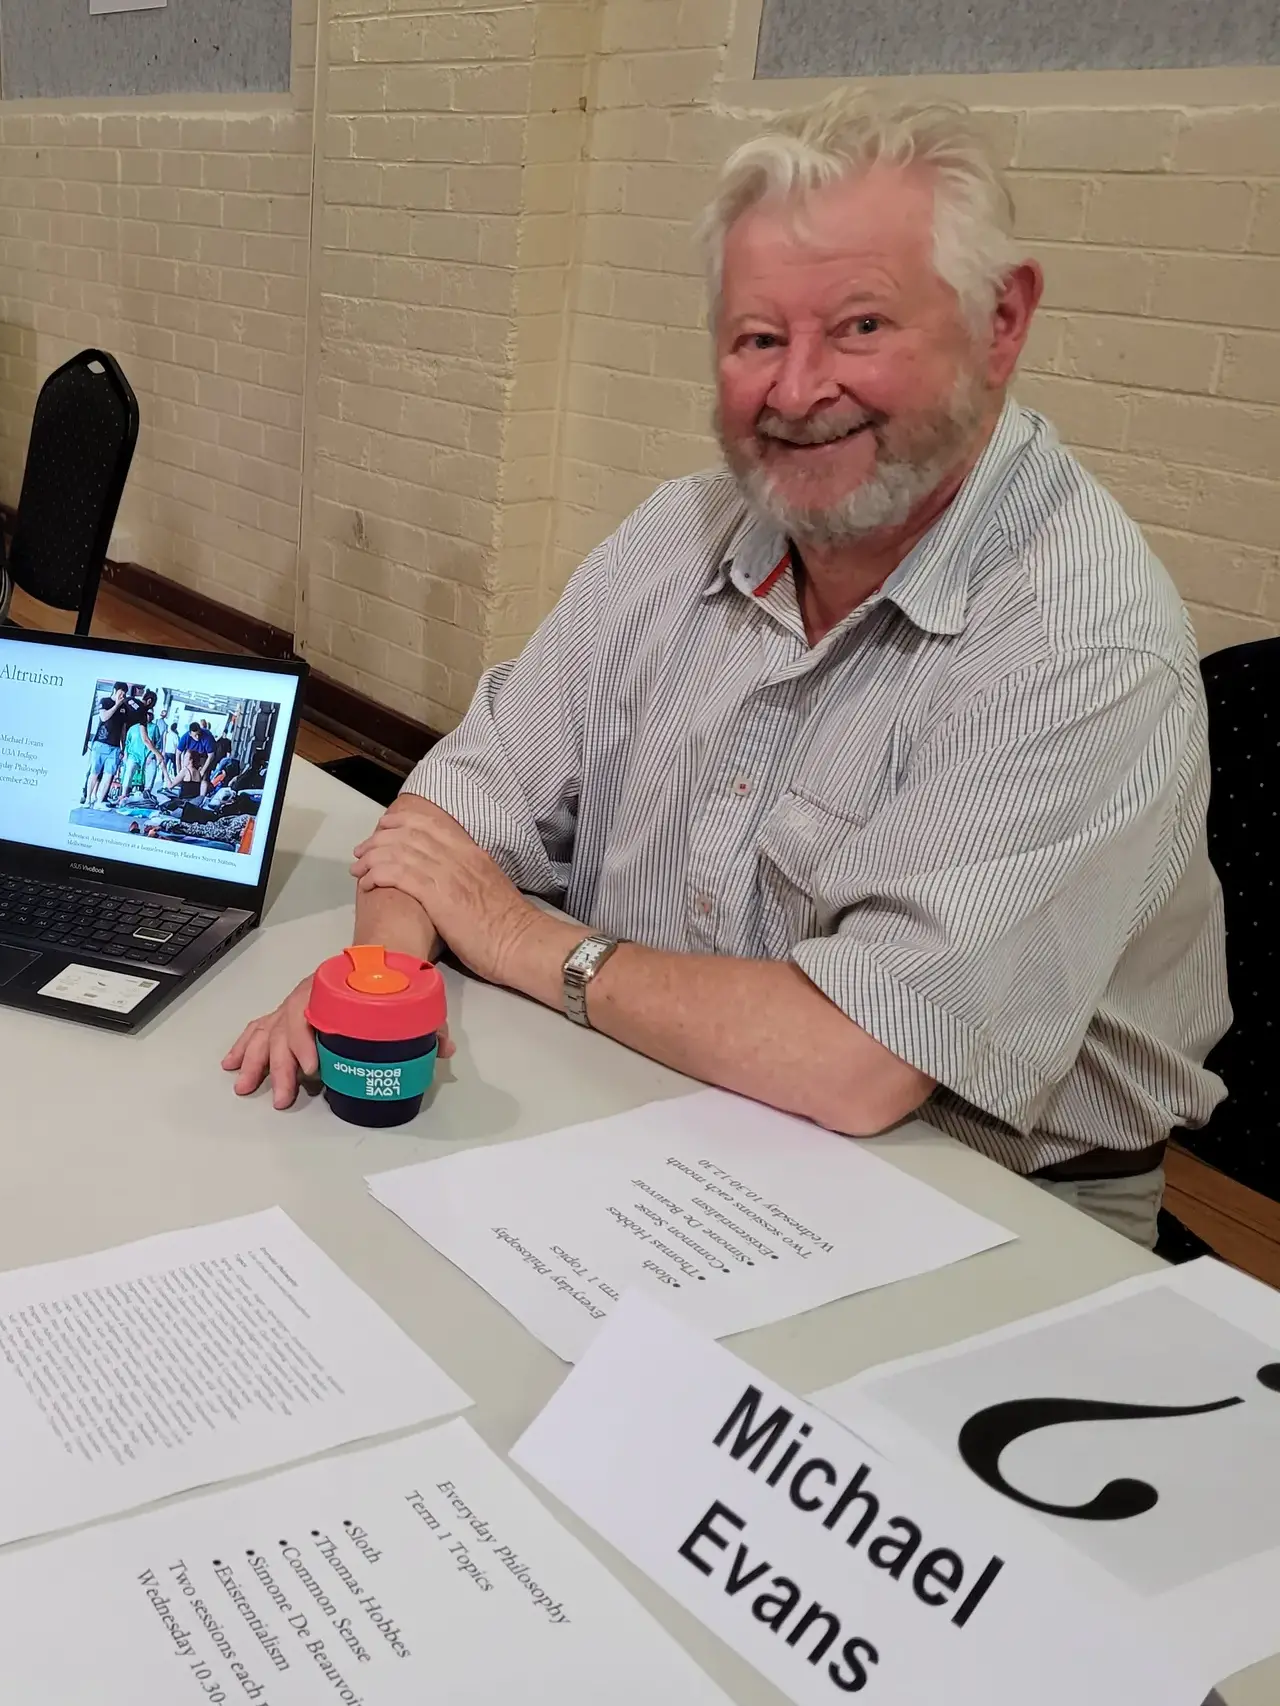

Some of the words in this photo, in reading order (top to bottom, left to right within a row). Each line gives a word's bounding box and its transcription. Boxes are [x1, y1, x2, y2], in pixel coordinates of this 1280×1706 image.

[0, 733, 24, 745] Michael
[14, 762, 48, 777] Philosophy
[333, 1062, 402, 1078] BOOKSHOP
[366, 1077, 401, 1087] YOUR
[666, 1156, 707, 1184] month
[631, 1178, 685, 1215] Beauvoir
[705, 1182, 735, 1202] each
[606, 1206, 653, 1241] Hobbes
[634, 1203, 669, 1227] Sense
[683, 1214, 704, 1229] De
[691, 1196, 774, 1257] Existentialism
[732, 1201, 784, 1237] sessions
[762, 1202, 835, 1253] Wednesday
[490, 1226, 553, 1276] Philosophy
[549, 1244, 589, 1278] Topics
[650, 1239, 700, 1278] Thomas
[667, 1225, 725, 1270] Common
[702, 1227, 751, 1263] Simone
[782, 1236, 813, 1260] Two
[641, 1259, 678, 1284] Sloth
[550, 1275, 607, 1320] Everyday
[711, 1383, 1006, 1629] Michael
[344, 1525, 383, 1564] Sloth
[404, 1489, 441, 1531] Term
[437, 1531, 453, 1541] 1
[448, 1540, 494, 1592] Topics
[436, 1480, 497, 1544] Everyday
[492, 1545, 572, 1625] Philosophy
[137, 1568, 196, 1657] Wednesday
[282, 1546, 337, 1617] Common
[332, 1617, 372, 1663] Sense
[314, 1535, 365, 1596] Thomas
[358, 1596, 411, 1659] Hobbes
[677, 1499, 880, 1694] Evans
[169, 1559, 196, 1596] Two
[190, 1599, 238, 1660] sessions
[231, 1659, 266, 1700] each
[214, 1565, 291, 1673] Existentialism
[247, 1556, 293, 1613] Simone
[288, 1612, 311, 1639] De
[306, 1639, 365, 1706] Beauvoi
